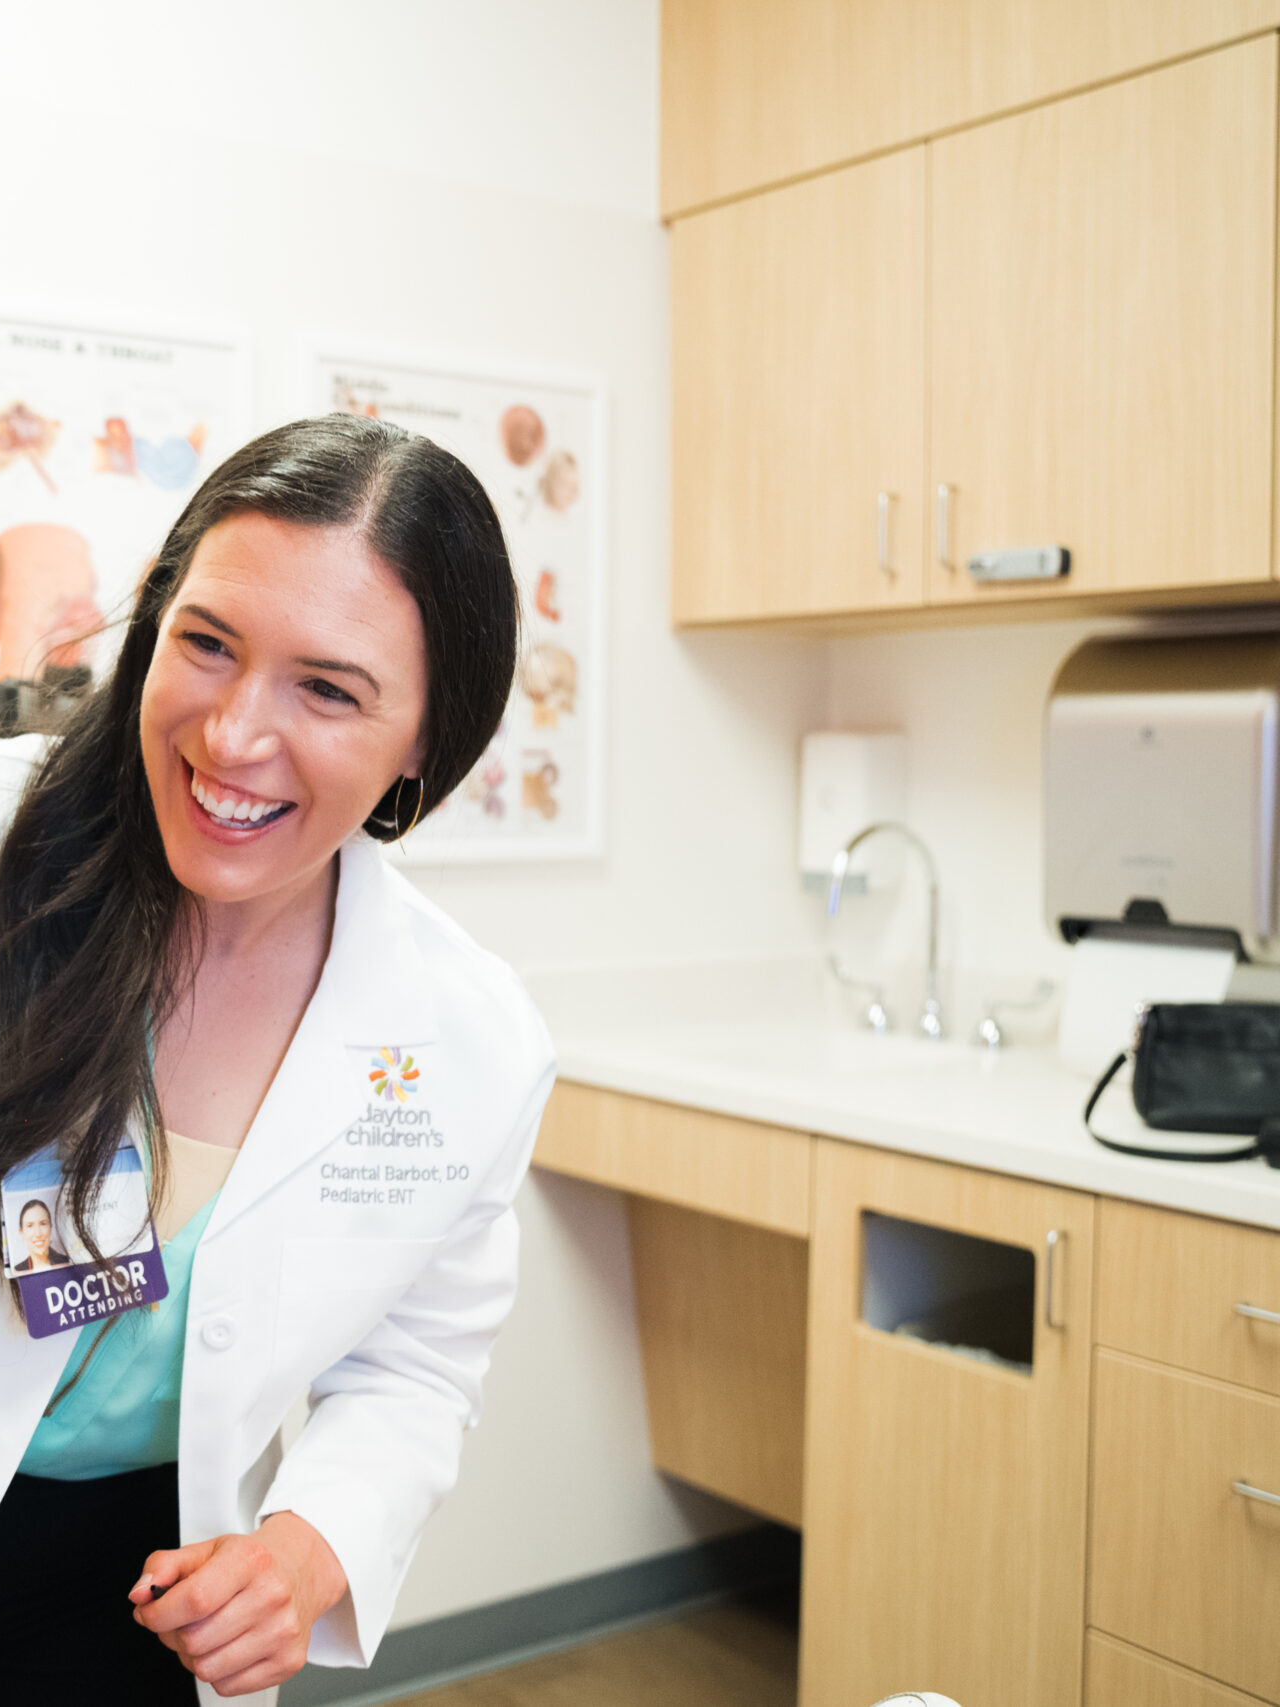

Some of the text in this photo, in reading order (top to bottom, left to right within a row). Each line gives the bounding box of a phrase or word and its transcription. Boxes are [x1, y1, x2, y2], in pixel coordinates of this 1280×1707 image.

[345, 1126, 445, 1148] children's
[320, 1163, 470, 1183] Chantal Barbot, DO
[320, 1187, 416, 1205] Pediatric ENT
[45, 1260, 148, 1314] DOCTOR
[59, 1289, 144, 1327] ATTENDING
